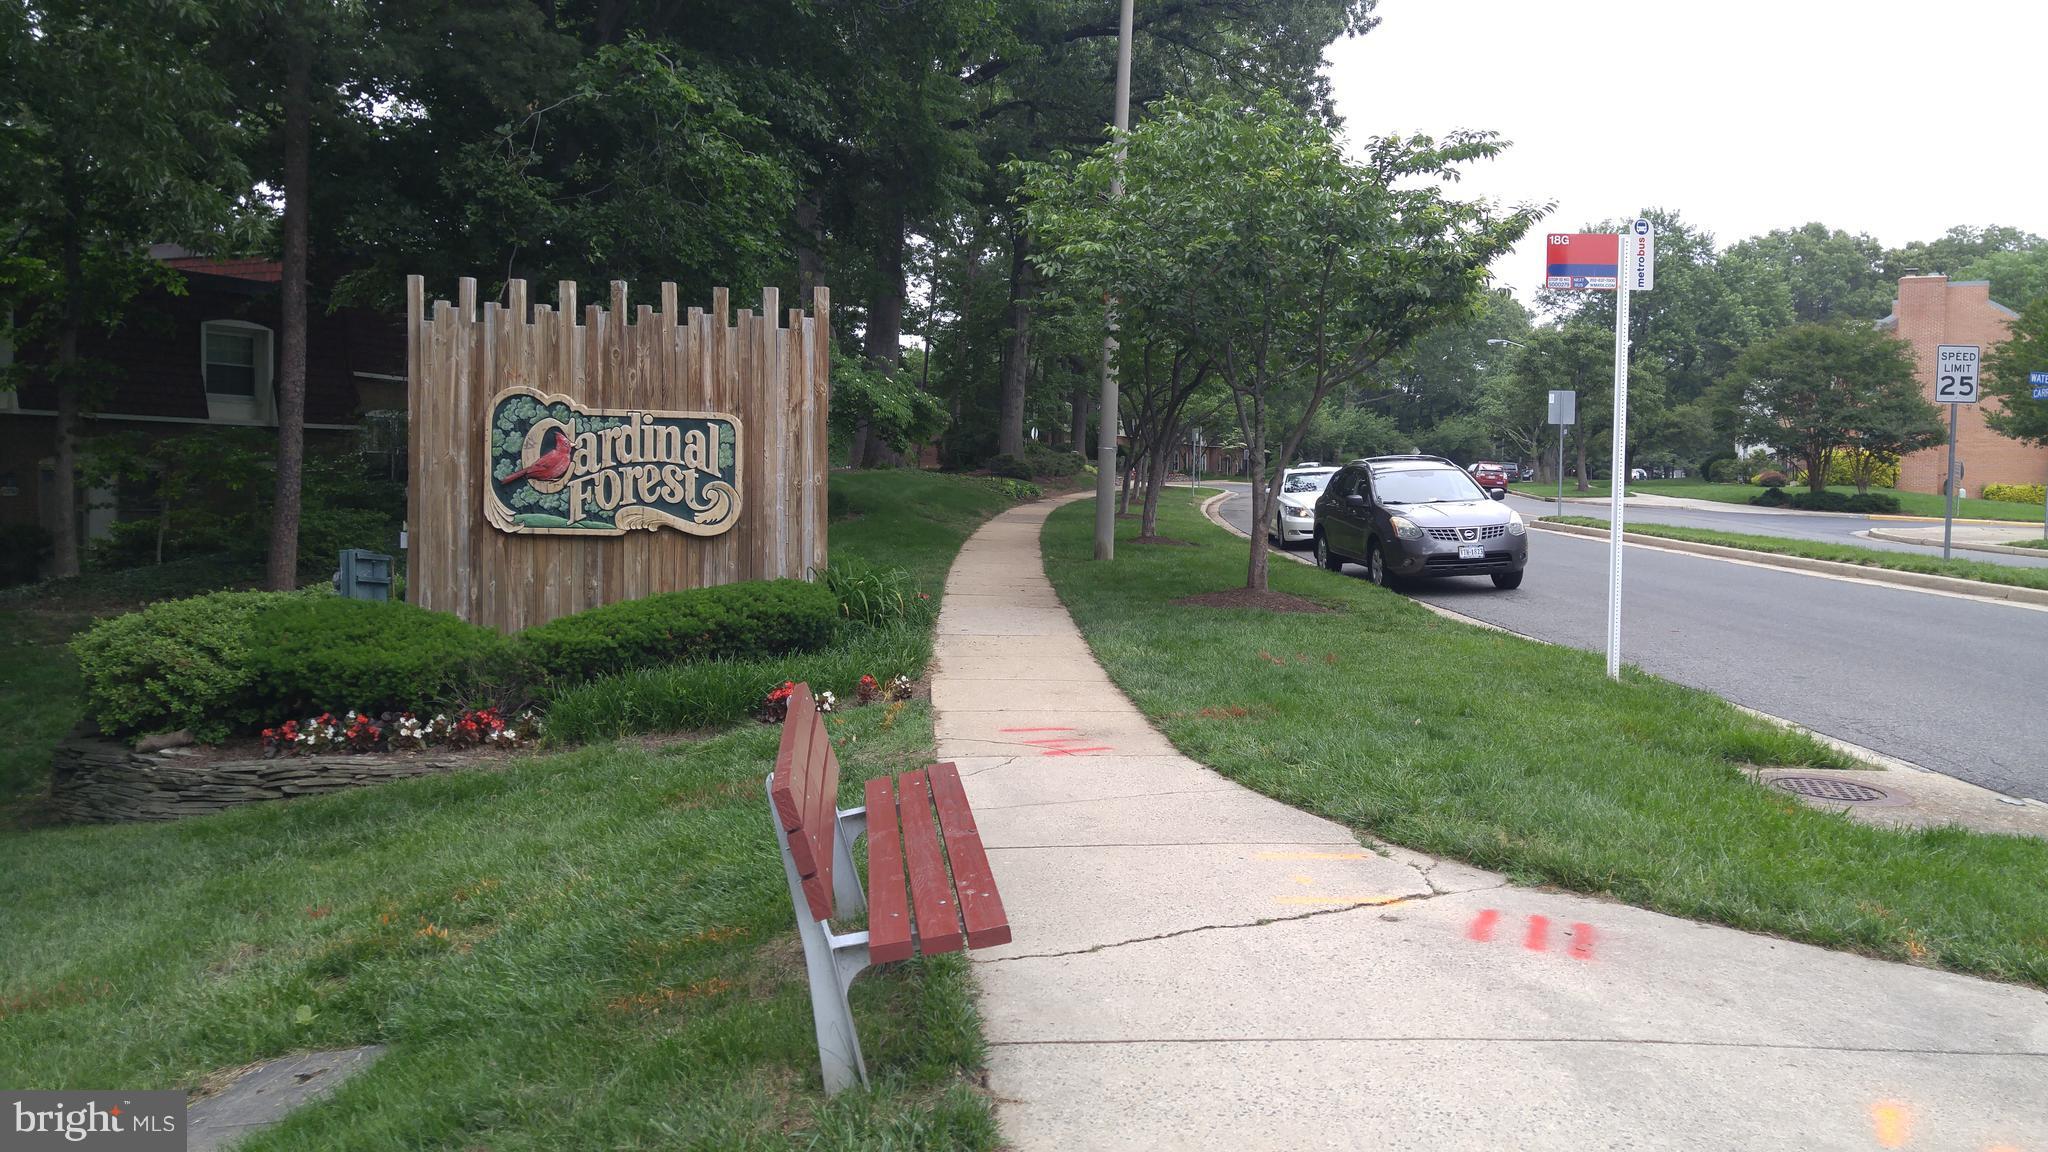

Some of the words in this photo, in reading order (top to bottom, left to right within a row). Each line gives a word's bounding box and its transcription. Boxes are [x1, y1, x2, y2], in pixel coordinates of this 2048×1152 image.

[1549, 235, 1569, 245] 18G
[1637, 237, 1645, 288] metrobus
[1941, 352, 1976, 361] SPEED
[1944, 364, 1972, 373] LIMIT
[1940, 375, 1974, 396] 25
[521, 411, 722, 494] Cardinal
[567, 464, 720, 526] Forest
